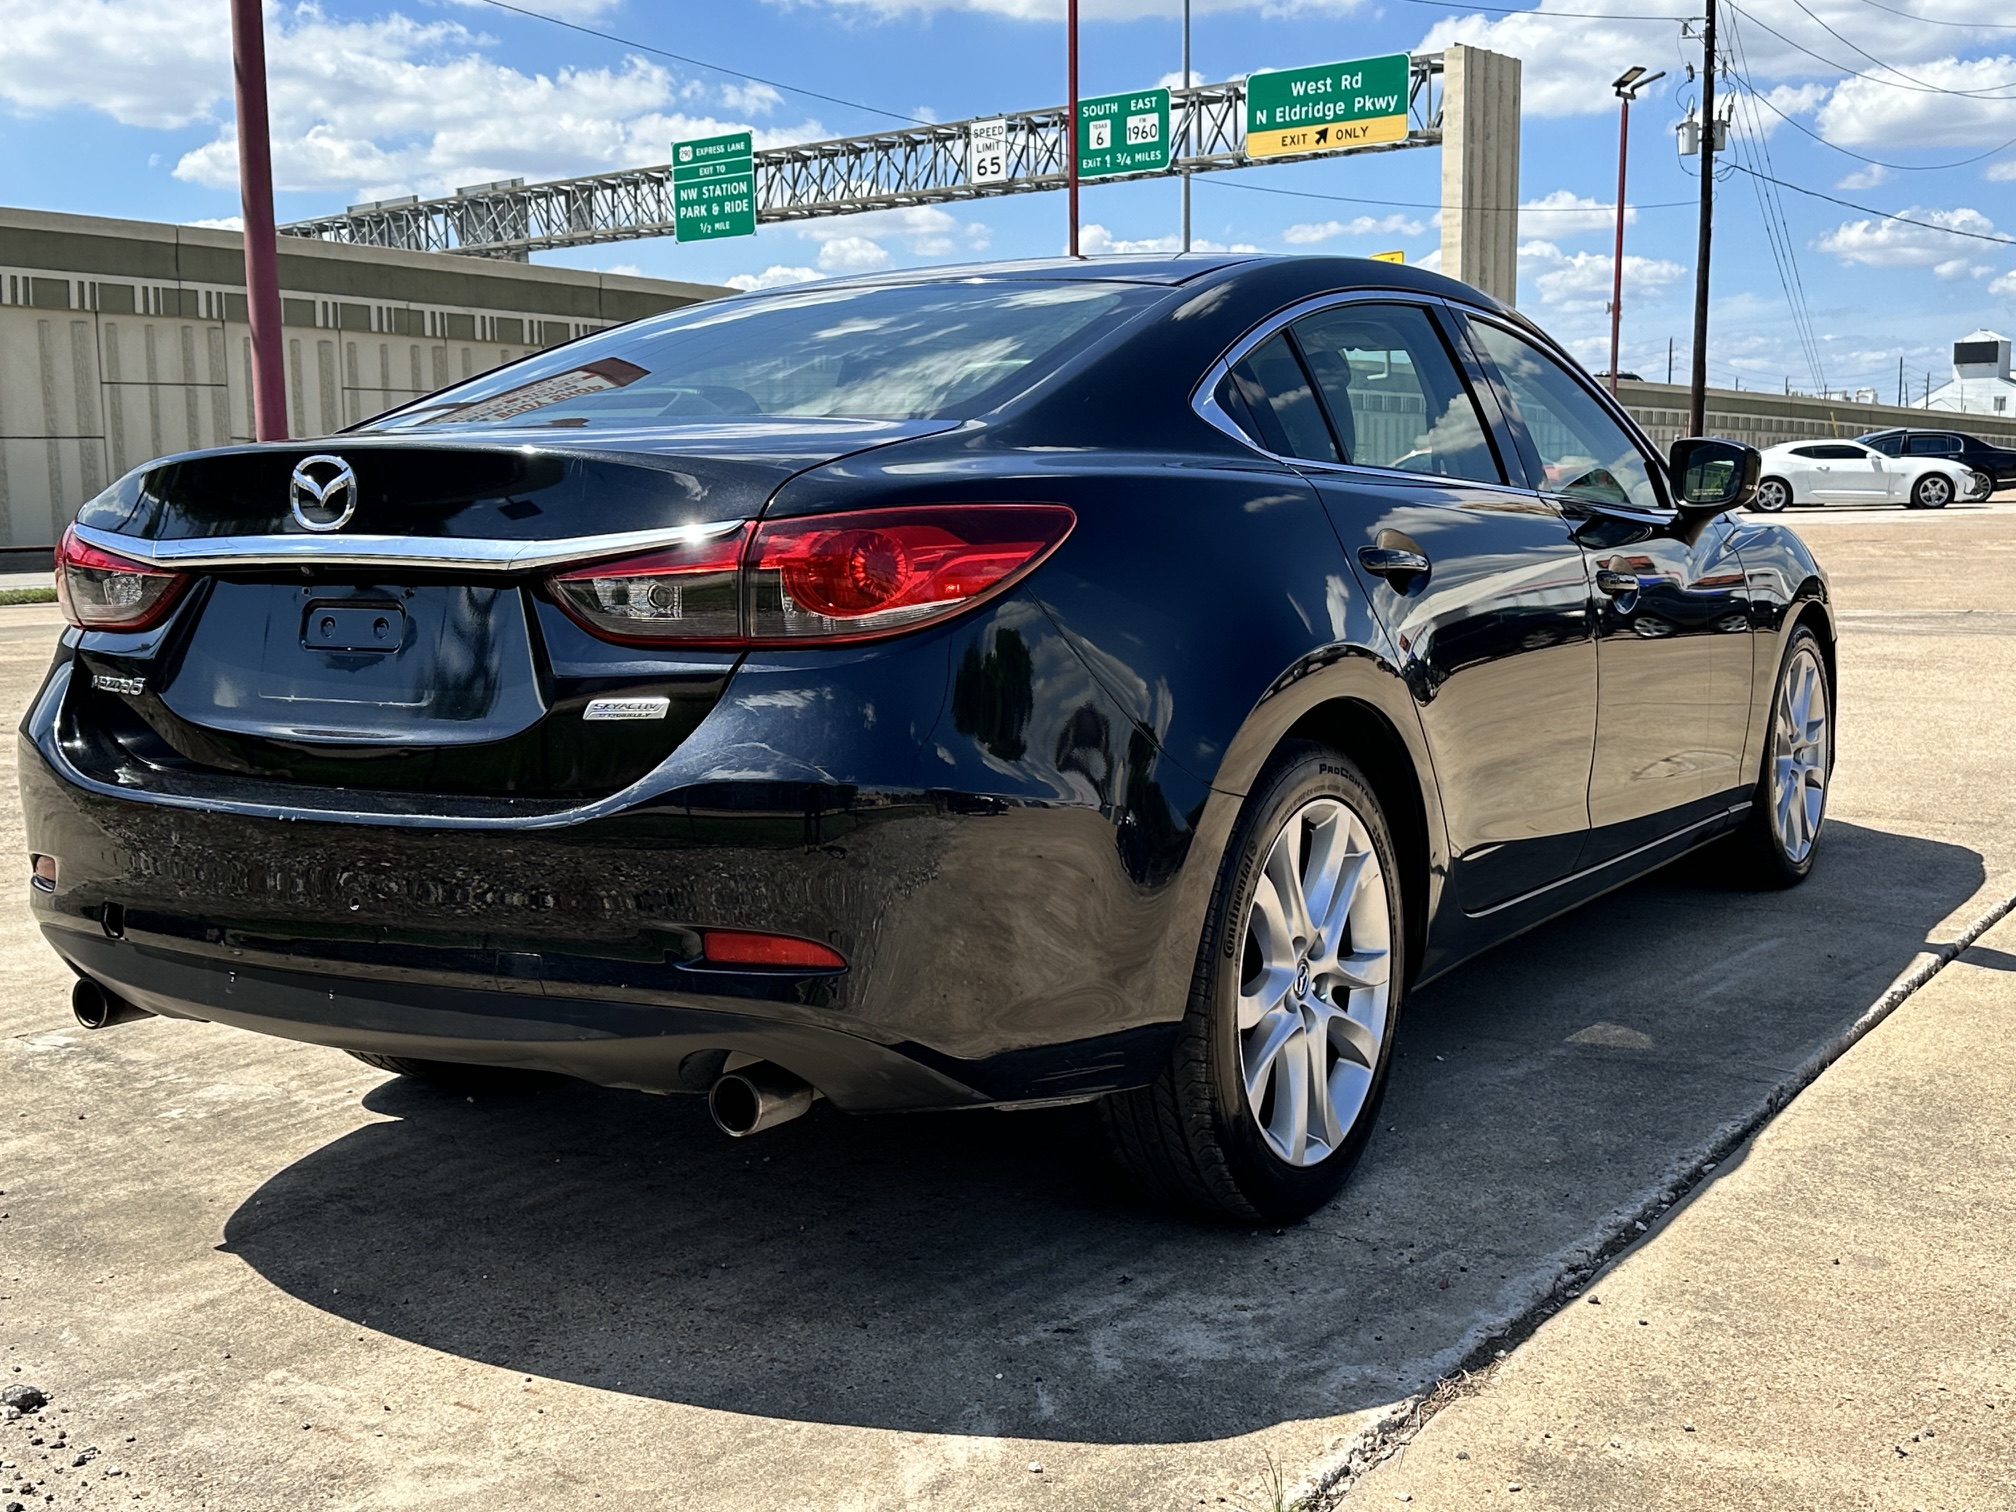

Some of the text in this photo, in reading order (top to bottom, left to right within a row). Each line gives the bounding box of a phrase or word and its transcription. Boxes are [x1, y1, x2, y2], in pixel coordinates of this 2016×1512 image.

[1291, 72, 1362, 97] West Rd
[1082, 96, 1157, 118] SOUTH EAST
[1256, 95, 1398, 125] N Eldridge Pkwy
[973, 125, 1004, 139] SPEED
[1096, 131, 1104, 146] 6
[1127, 123, 1158, 142] 1960
[1281, 126, 1369, 147] EXIT ONLY
[680, 141, 745, 160] 290 EXPRESS LANE
[976, 140, 1002, 154] LIMIT
[976, 156, 1001, 176] 65
[1082, 157, 1101, 169] EXIT
[1105, 154, 1111, 168] 1
[1135, 150, 1162, 163] MILES
[699, 164, 726, 176] EXIT TO
[680, 181, 748, 201] NW STATION
[680, 199, 749, 219] PARK & RIDE
[714, 221, 730, 231] MILE
[593, 702, 659, 710] SKYACTIV
[1222, 852, 1255, 959] Continental
